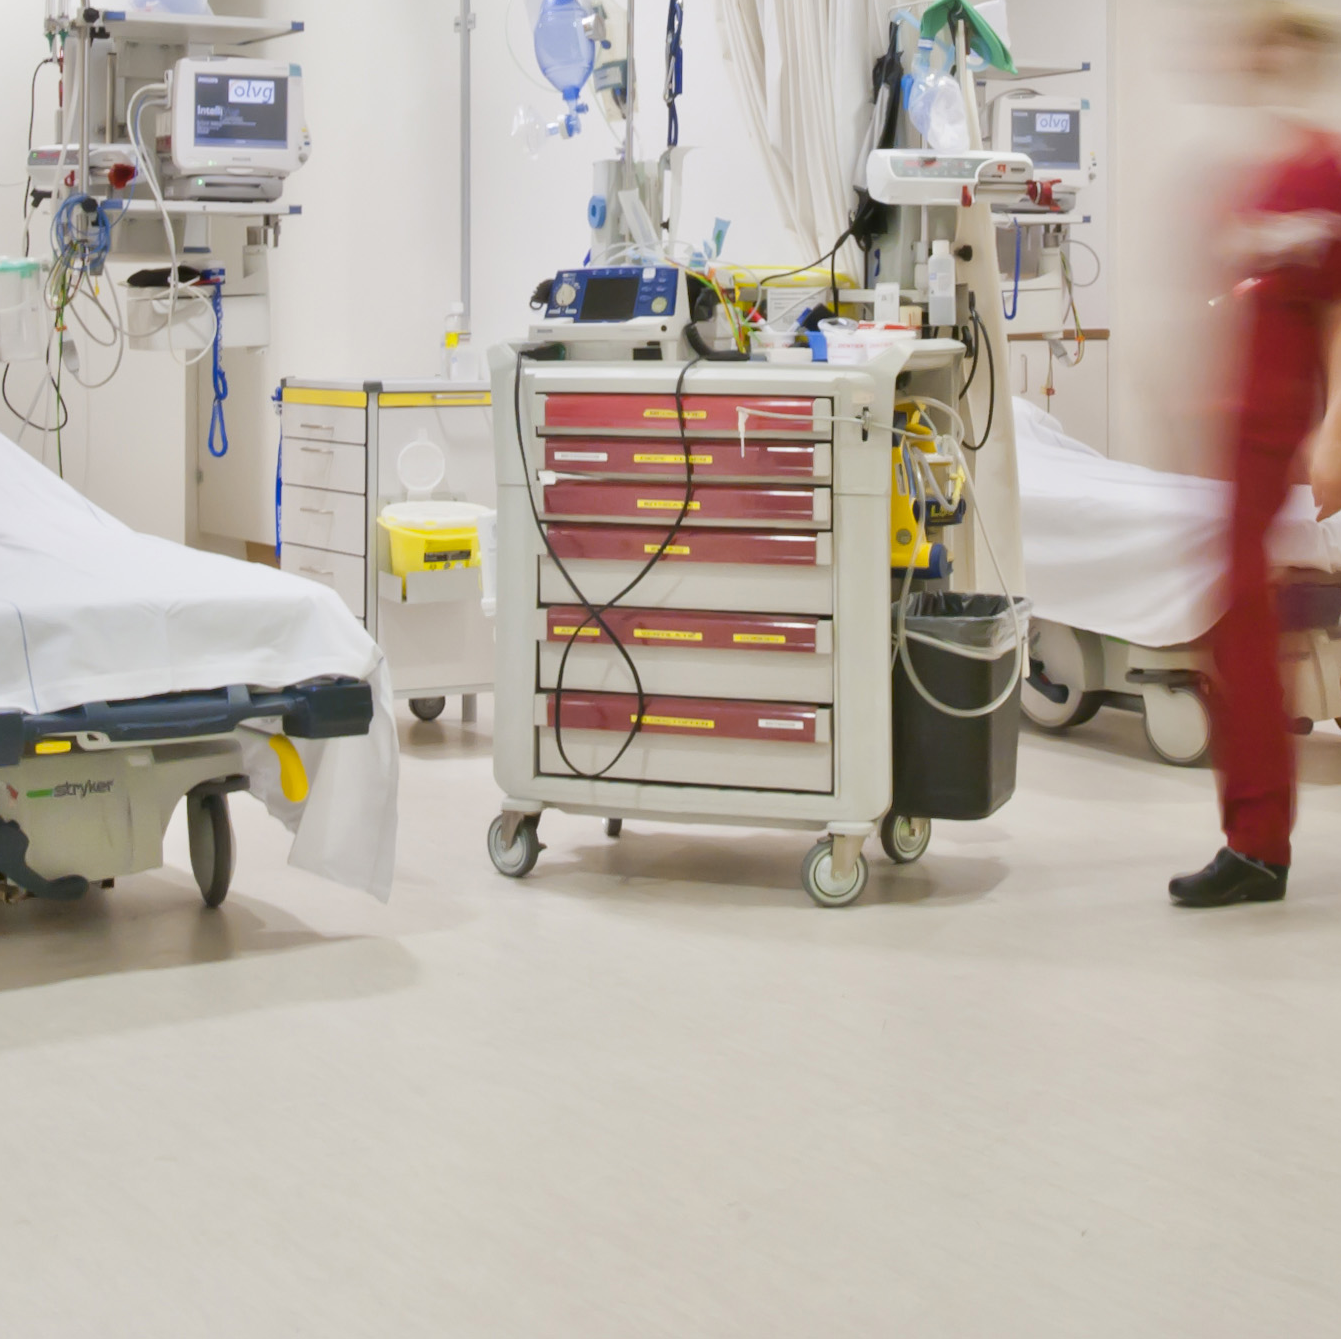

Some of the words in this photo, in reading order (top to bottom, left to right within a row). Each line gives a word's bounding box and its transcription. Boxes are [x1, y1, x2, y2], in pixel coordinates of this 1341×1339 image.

[234, 80, 274, 104] olvg
[1039, 113, 1070, 133] olvg
[53, 779, 115, 800] stryker
